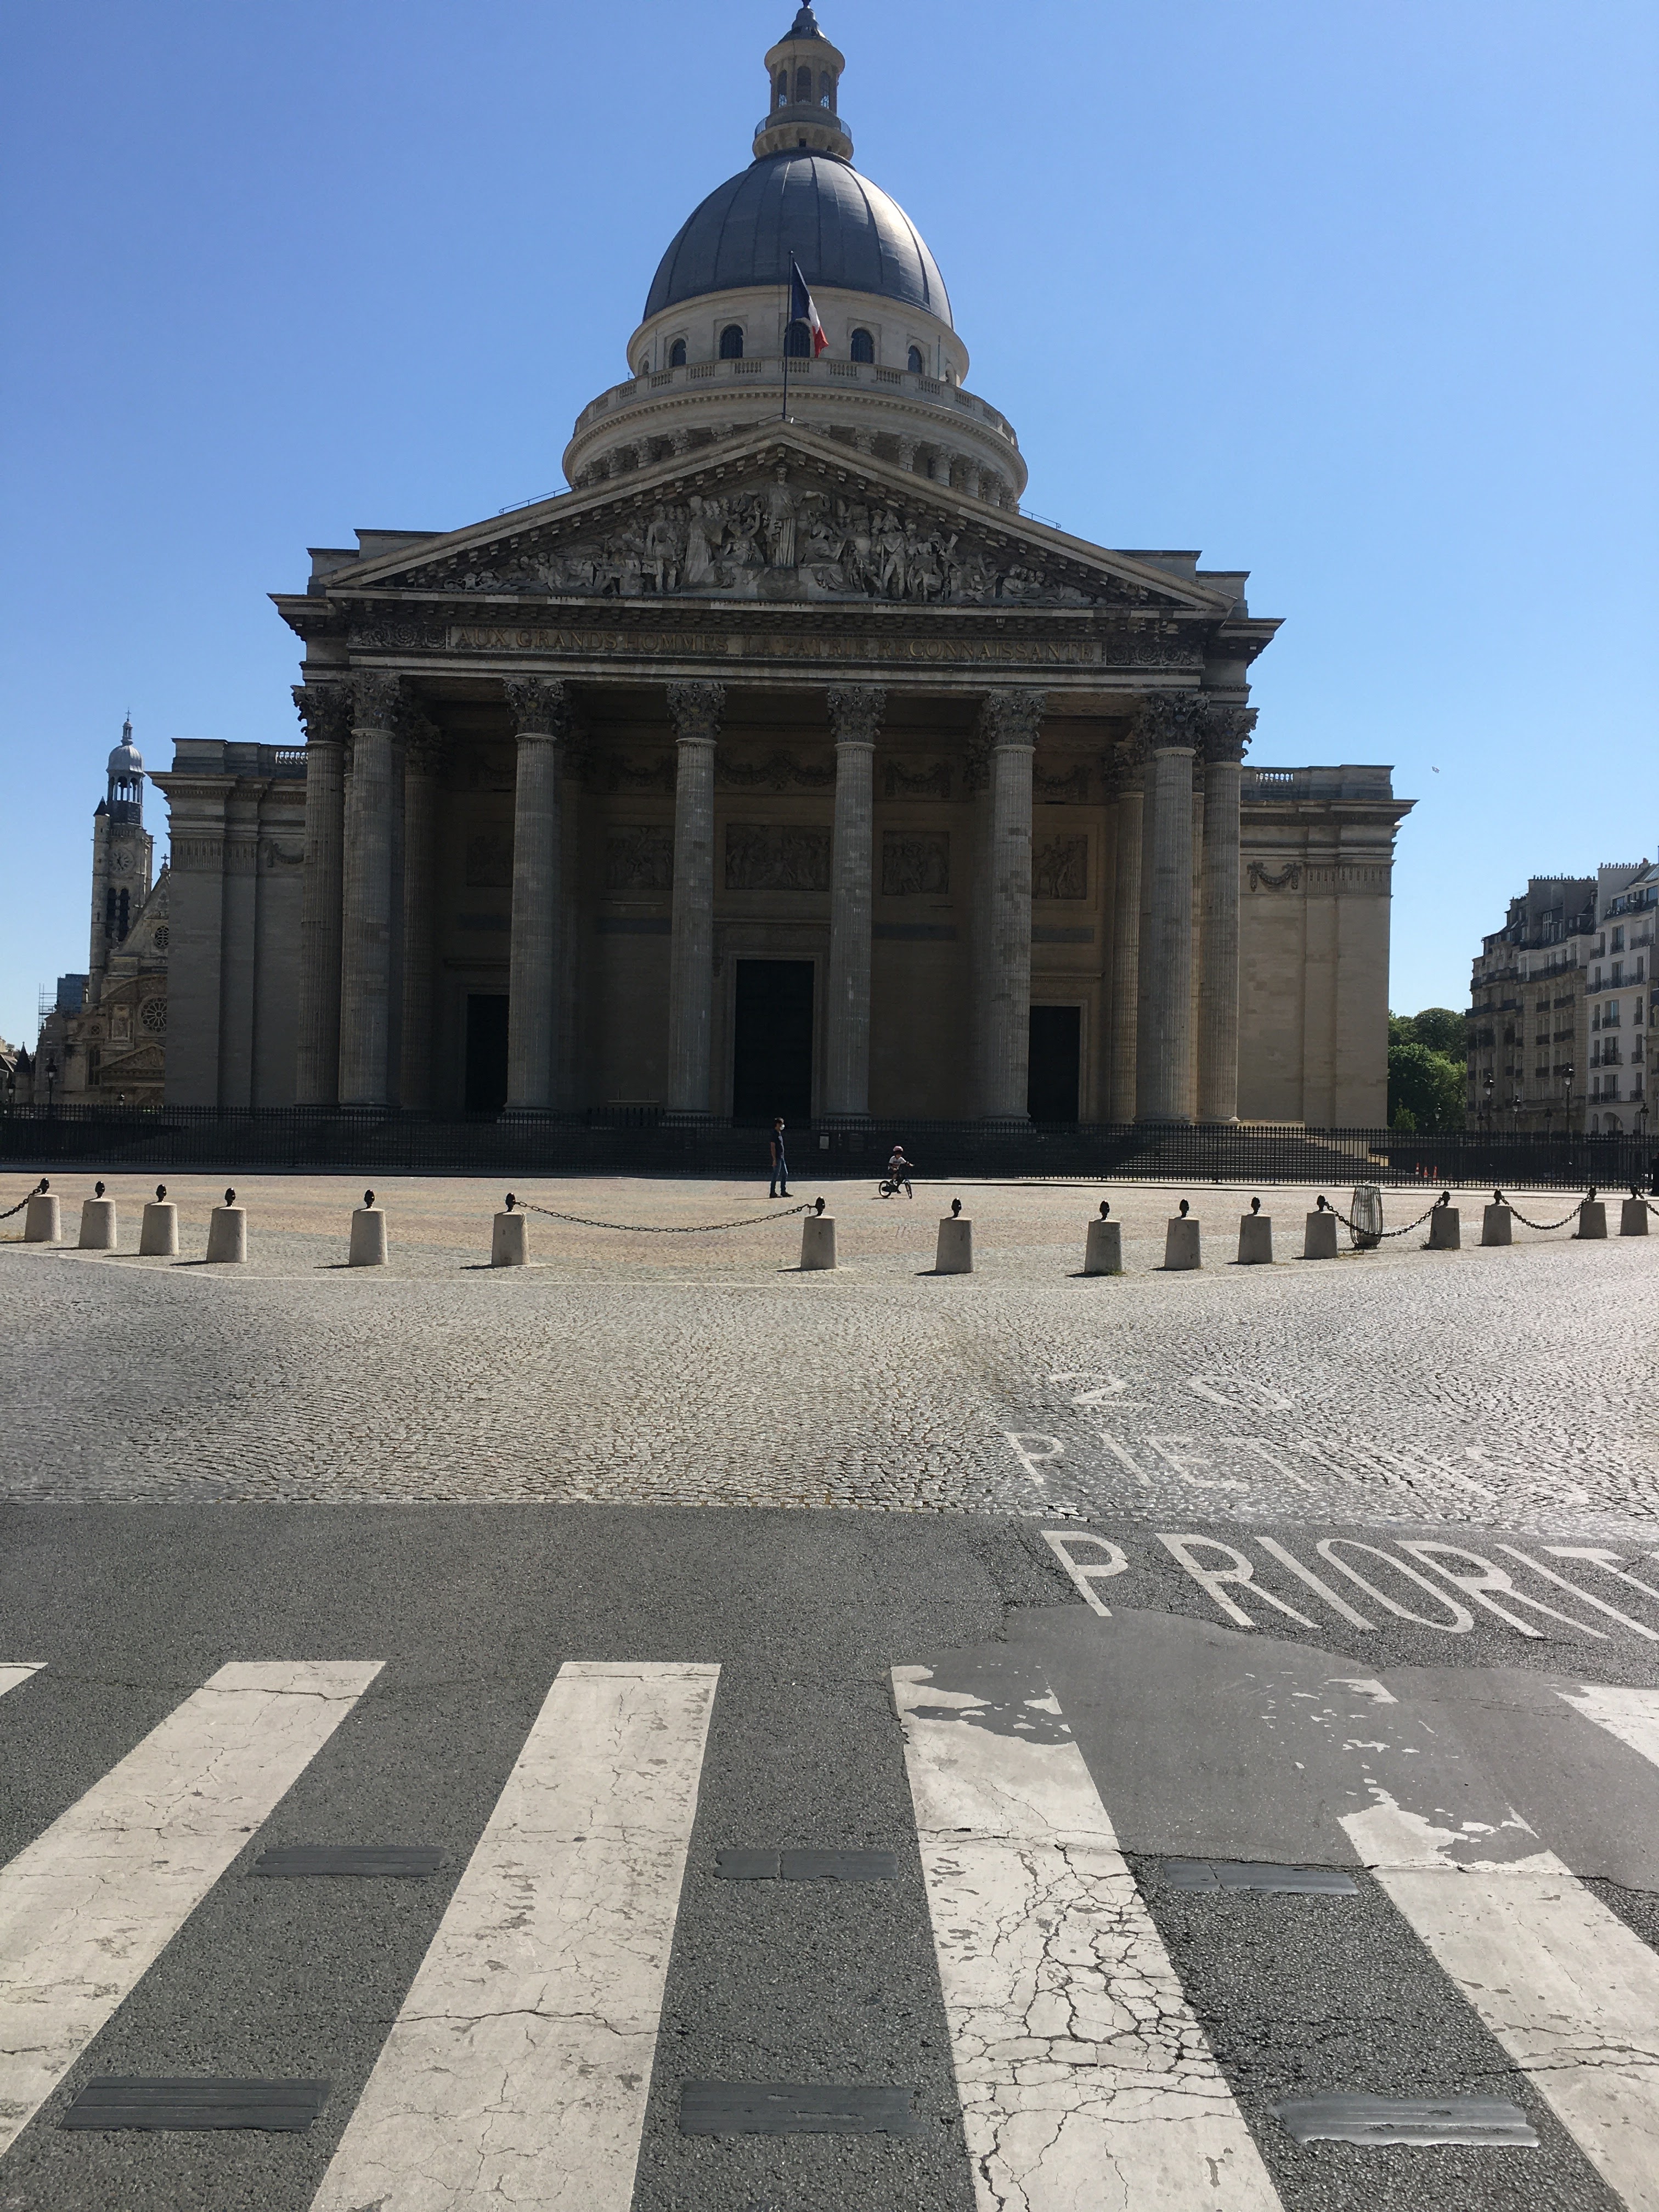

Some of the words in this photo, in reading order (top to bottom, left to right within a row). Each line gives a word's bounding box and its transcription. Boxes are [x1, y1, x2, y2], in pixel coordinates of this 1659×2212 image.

[456, 628, 510, 647] AUX
[516, 630, 618, 650] GRANDS
[623, 632, 729, 653] HOMMES
[877, 639, 1094, 661] RECONNAISSANTE
[1041, 1530, 1659, 1641] PRIORIT
